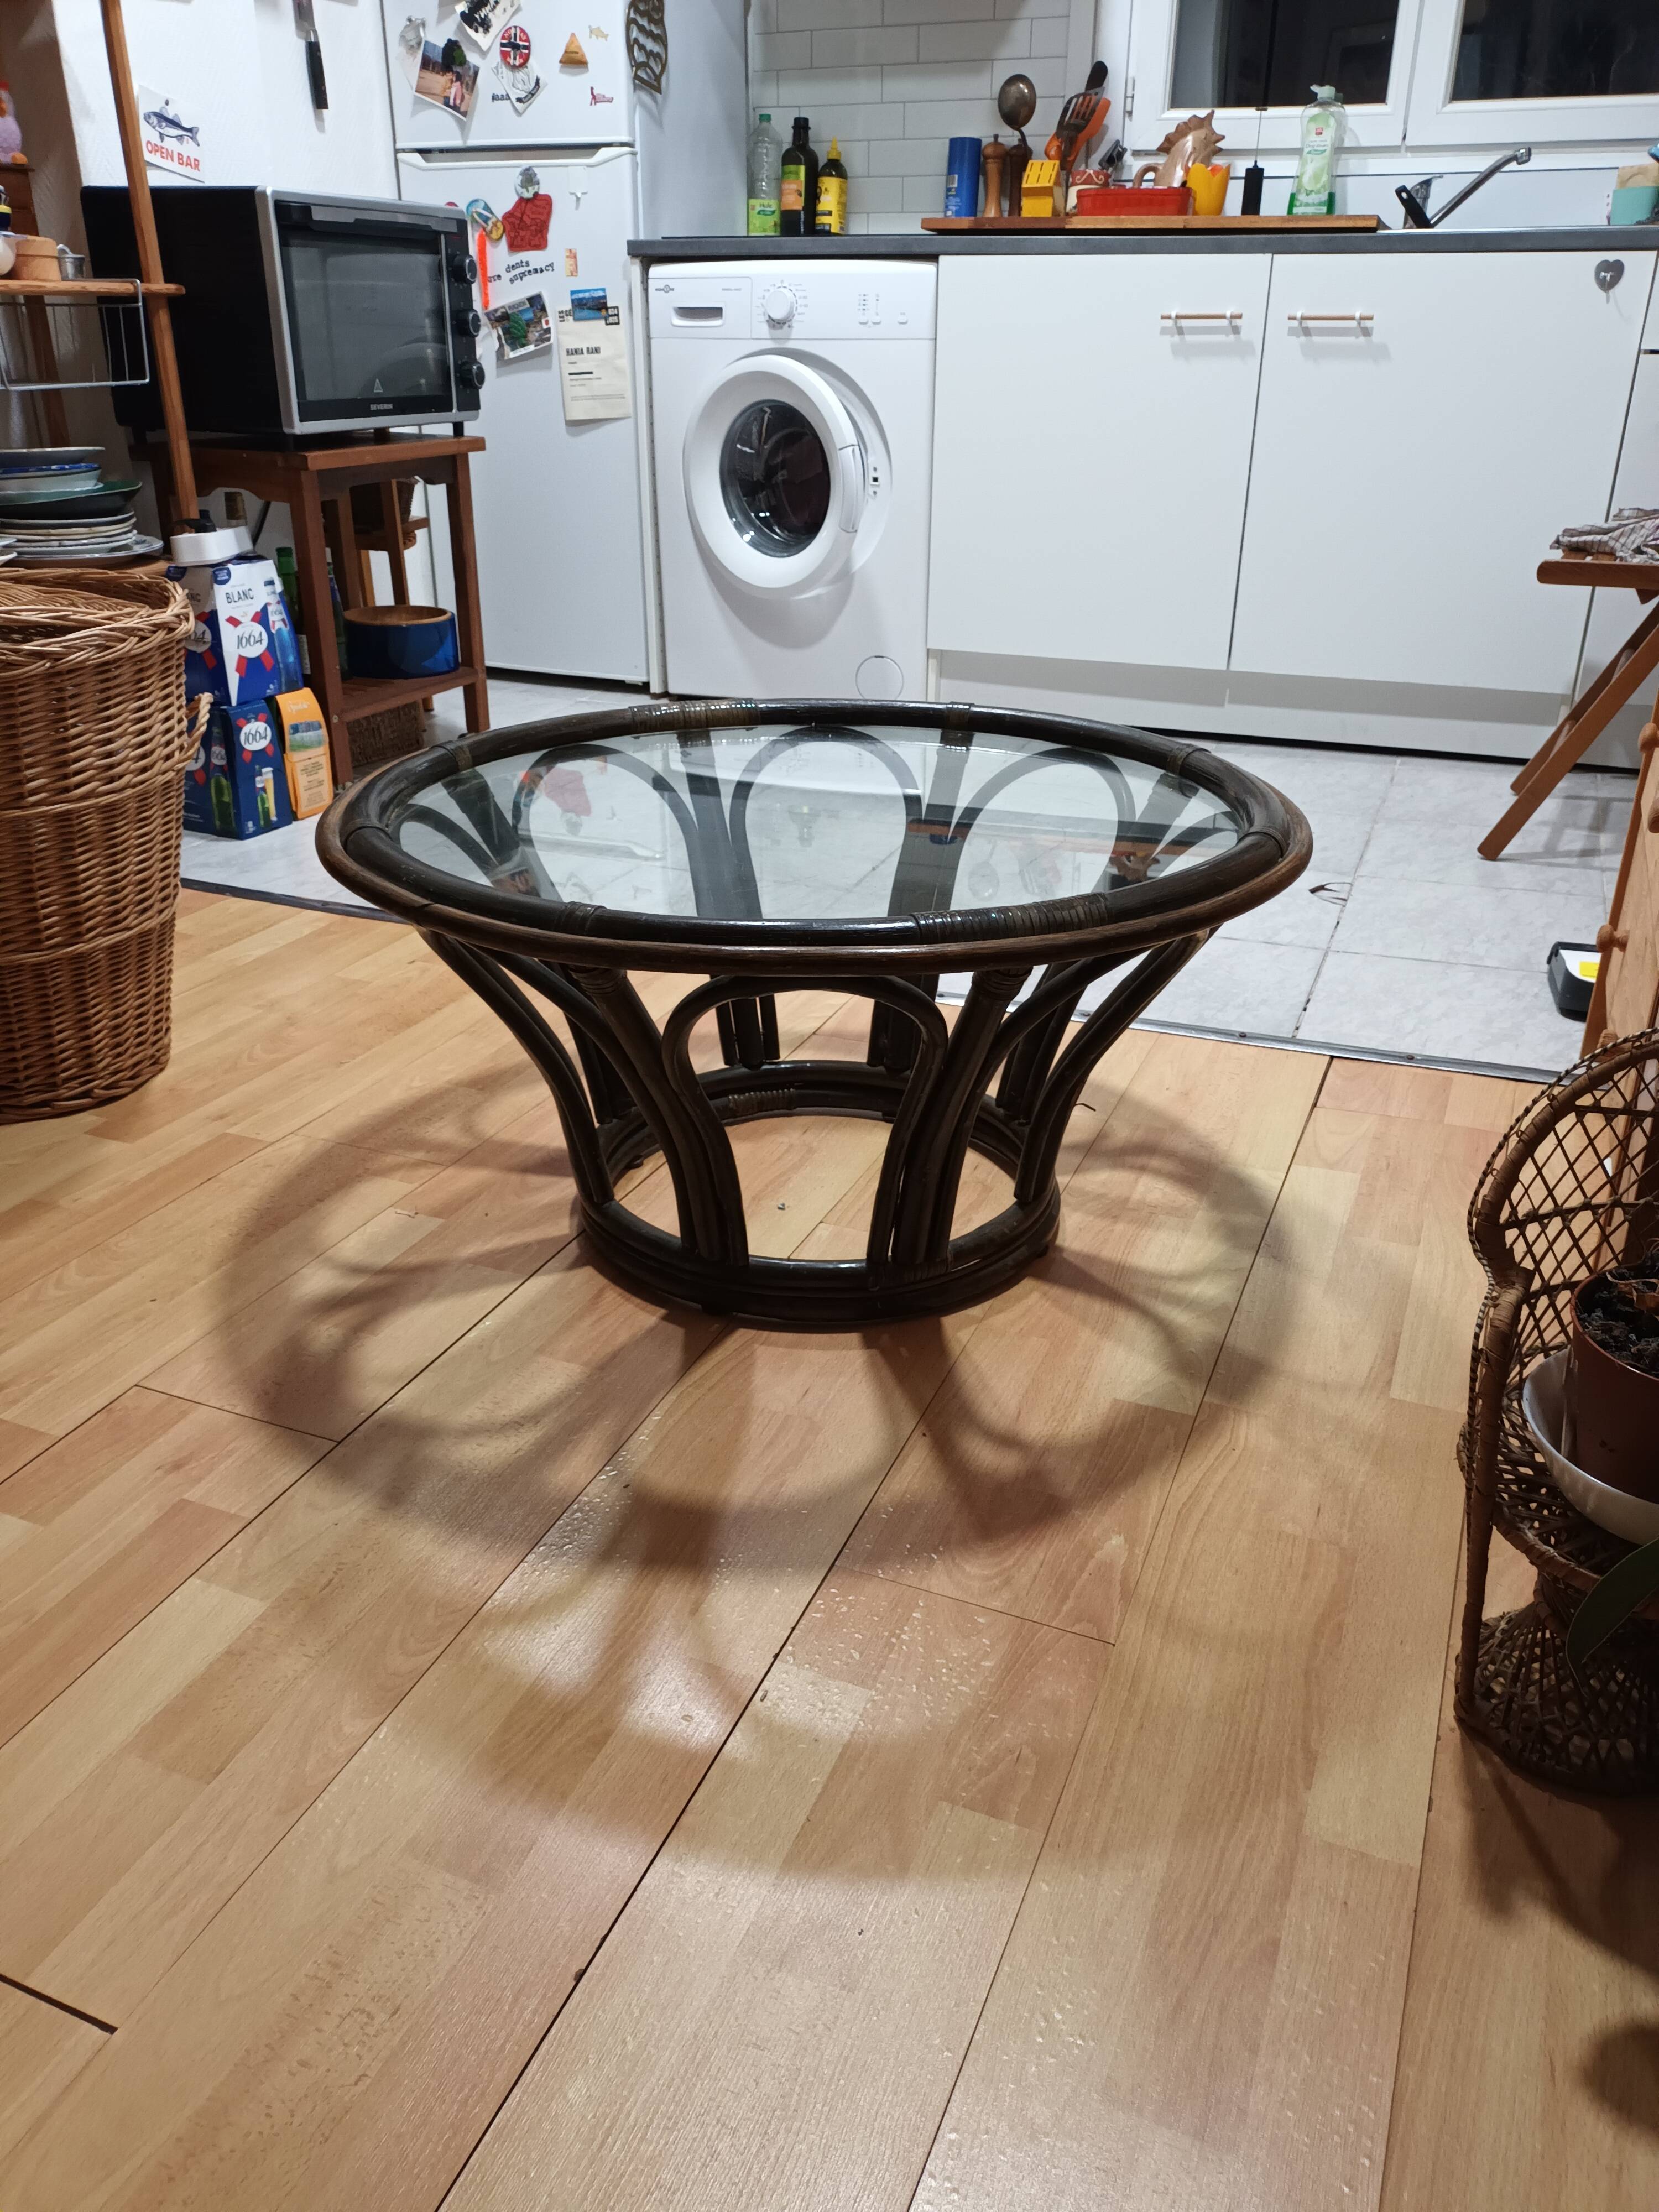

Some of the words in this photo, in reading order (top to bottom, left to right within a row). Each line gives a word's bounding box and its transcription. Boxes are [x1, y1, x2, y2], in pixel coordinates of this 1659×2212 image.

[146, 140, 174, 163] OPEN
[177, 152, 200, 172] BAR
[505, 259, 530, 273] dents
[509, 262, 555, 285] supremacy
[226, 588, 254, 604] BLANC
[237, 630, 264, 650] 1664
[243, 726, 268, 746] 1664
